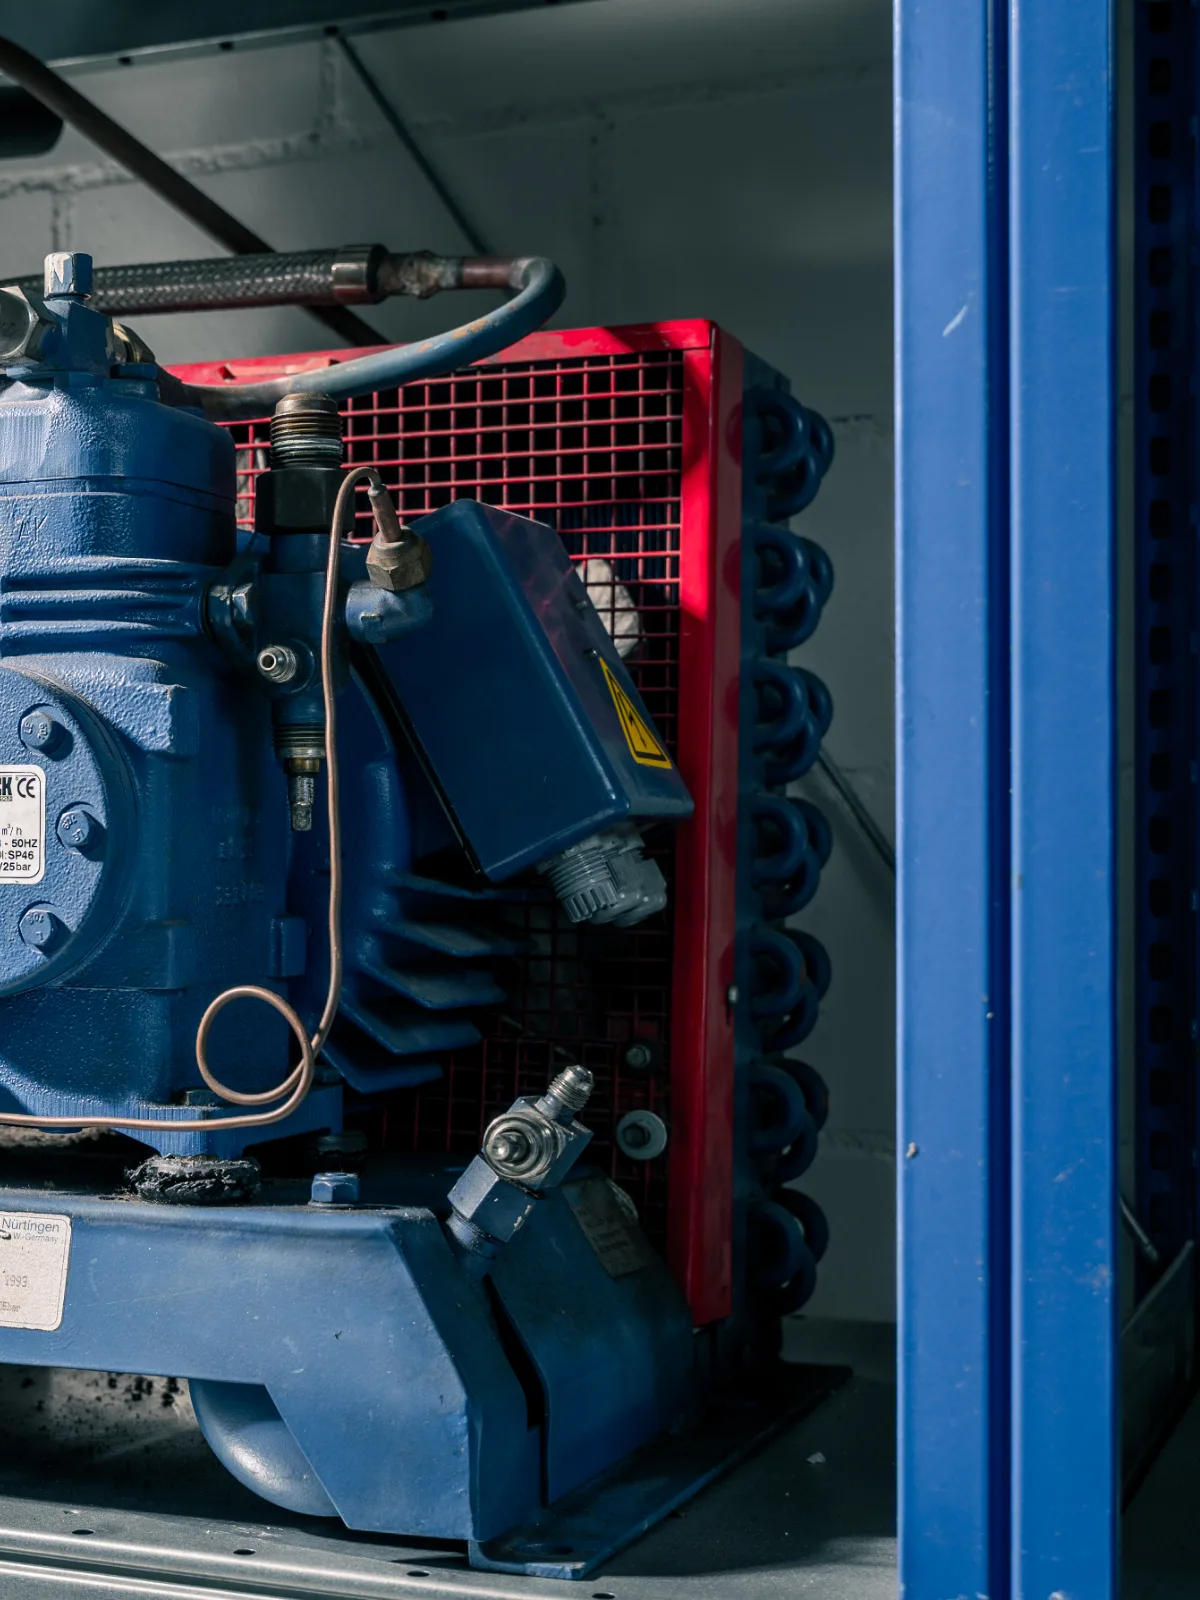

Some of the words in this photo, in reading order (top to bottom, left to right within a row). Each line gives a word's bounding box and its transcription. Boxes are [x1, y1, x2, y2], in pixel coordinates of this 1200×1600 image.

[16, 777, 36, 799] CE
[11, 839, 38, 847] 50HZ
[1, 1218, 60, 1234] Nürtingen
[4, 1275, 28, 1287] 1993
